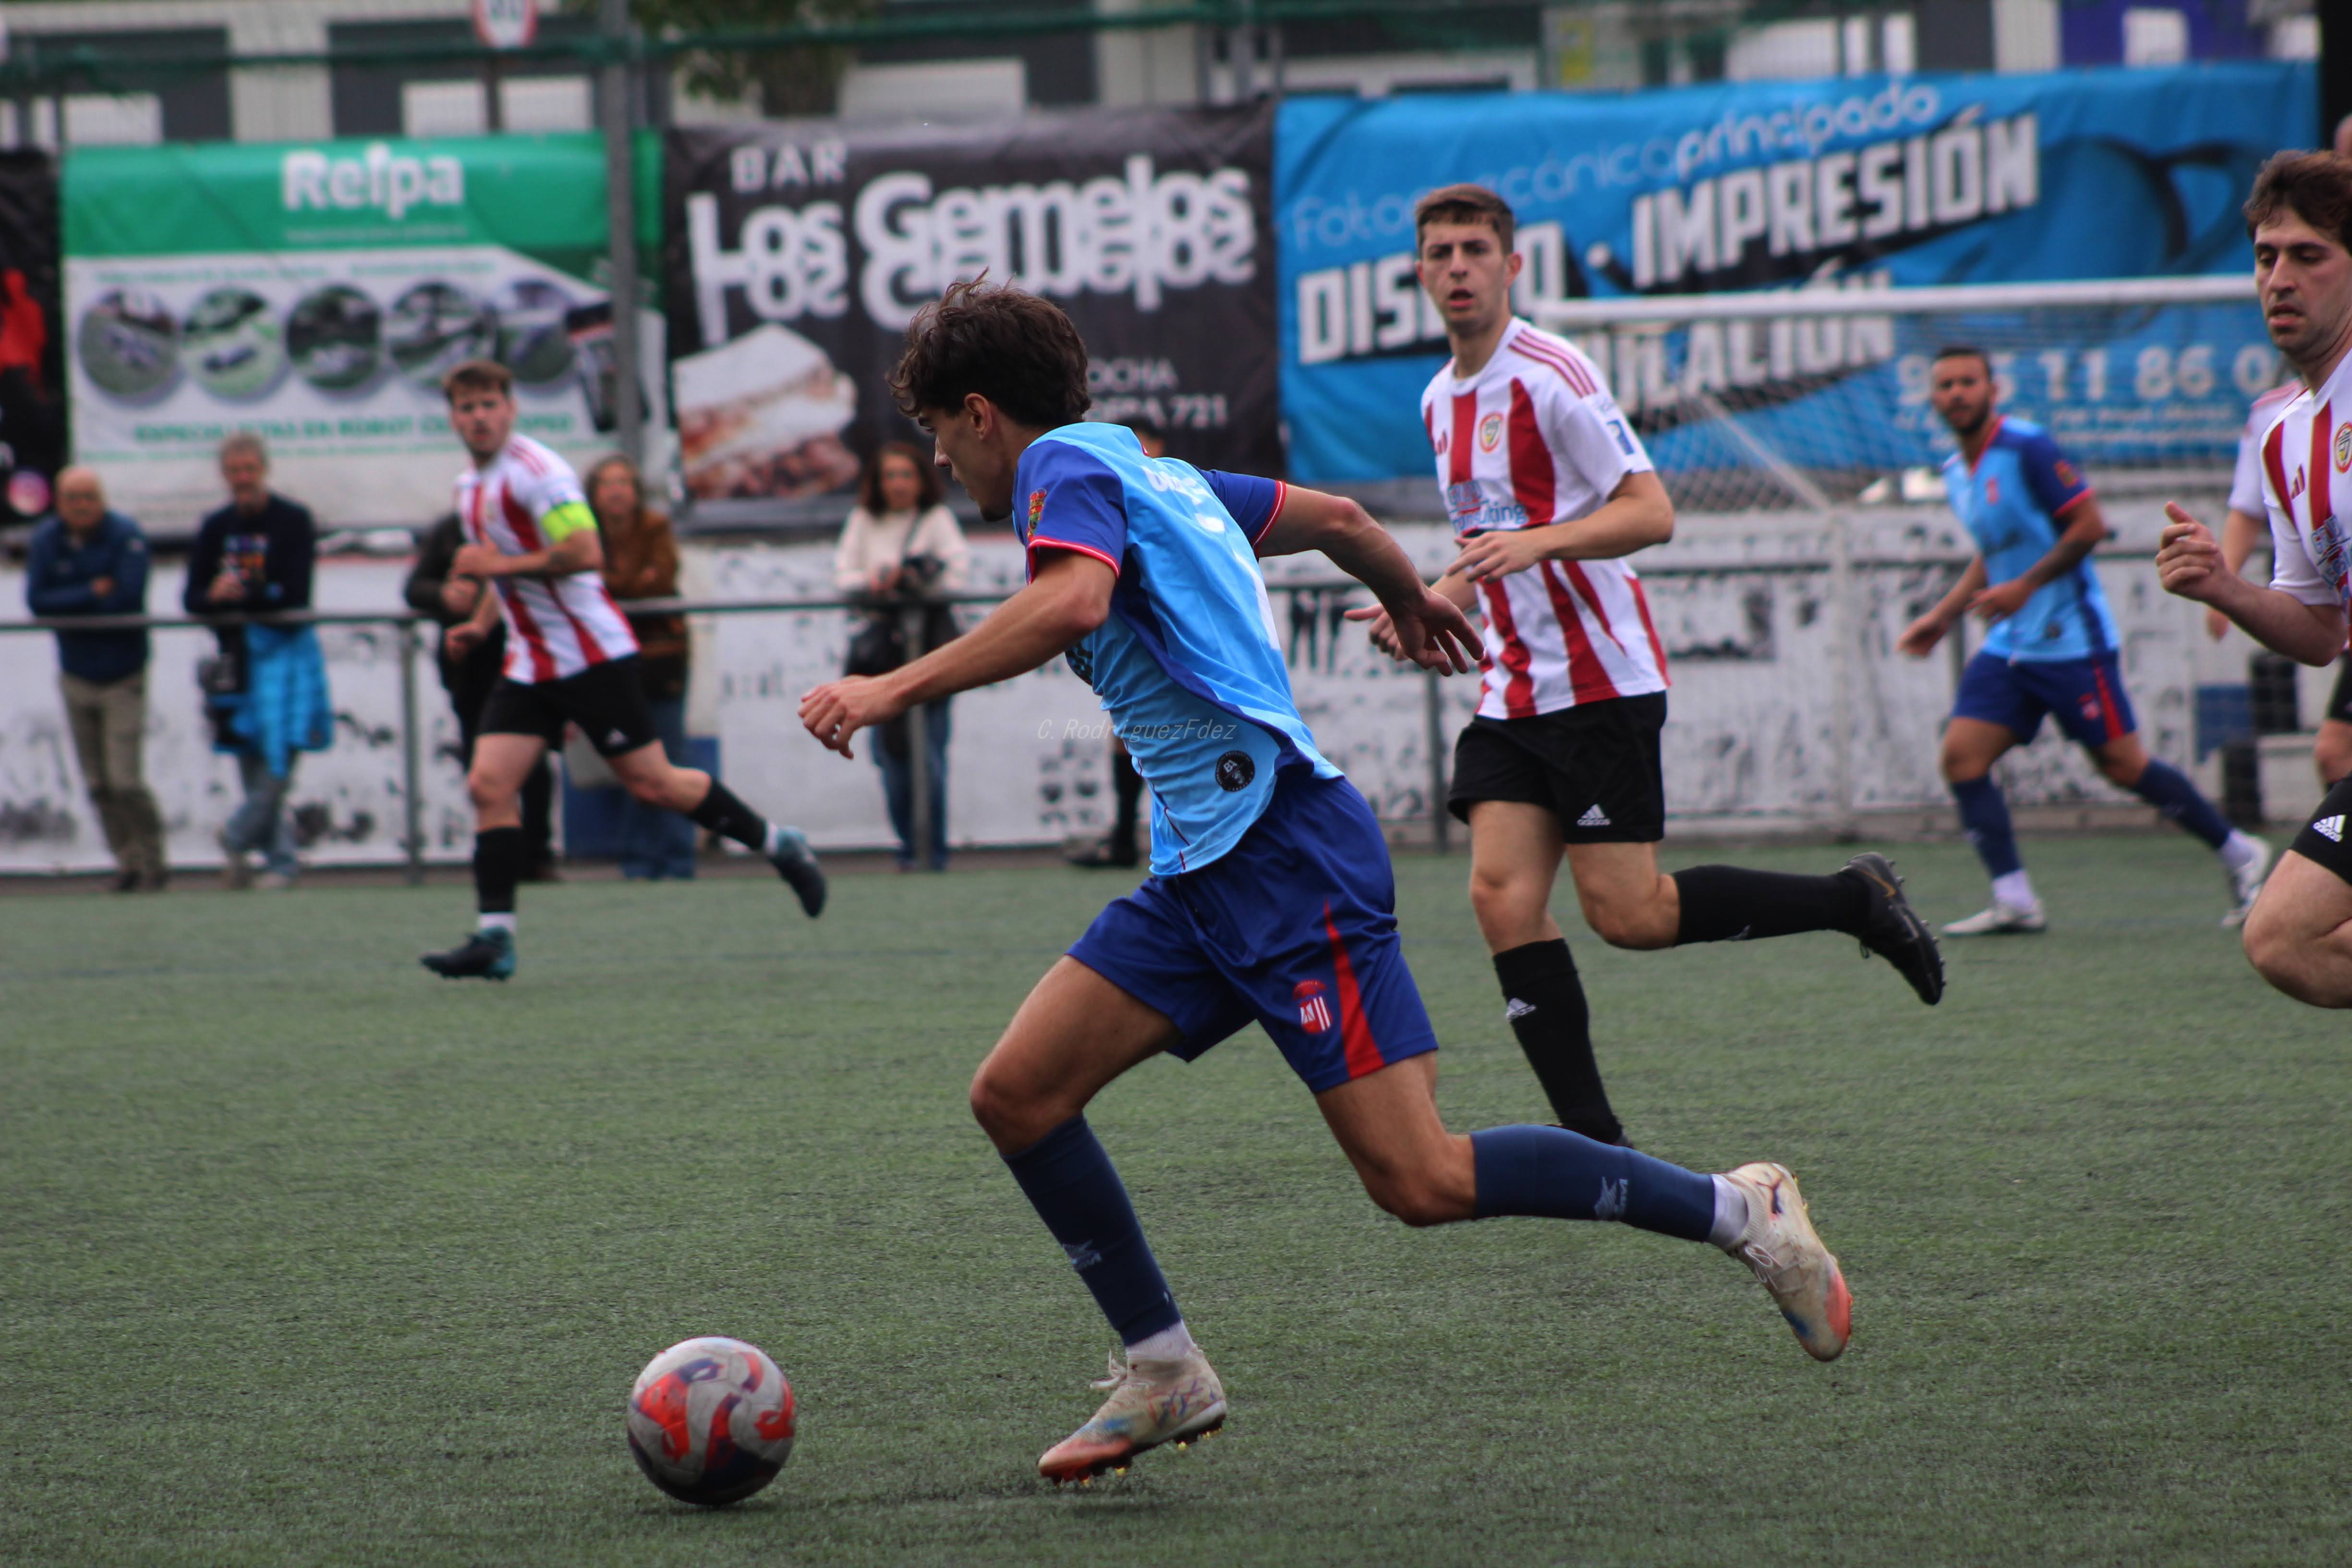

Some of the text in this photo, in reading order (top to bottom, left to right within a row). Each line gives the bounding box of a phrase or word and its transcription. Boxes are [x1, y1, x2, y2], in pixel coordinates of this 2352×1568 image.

[731, 142, 847, 191] BAR
[687, 155, 1255, 345] Los Gemelos
[1297, 103, 2038, 366] DISO IMPRESIÓN
[1895, 352, 2017, 405] 95
[2038, 350, 2109, 401] 11
[2134, 344, 2216, 399] 86
[1171, 394, 1227, 426] 721
[2312, 821, 2343, 842] adidas
